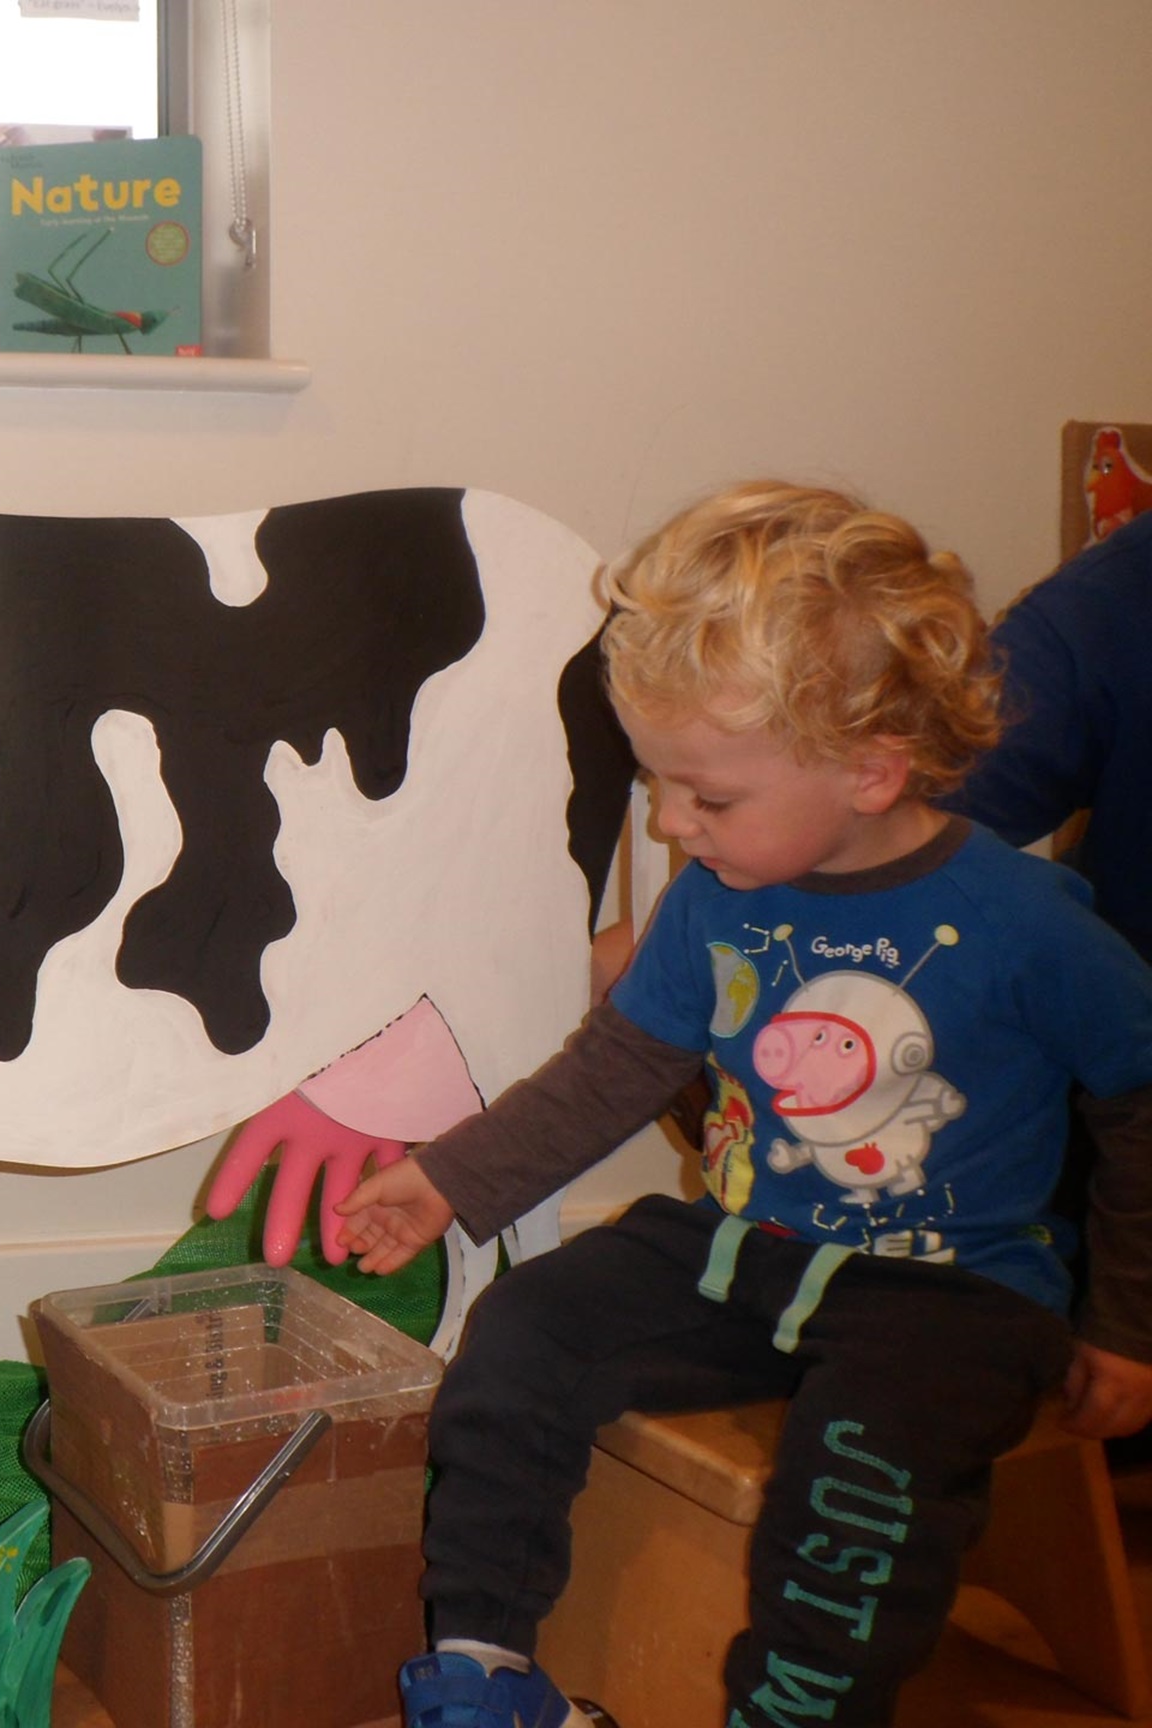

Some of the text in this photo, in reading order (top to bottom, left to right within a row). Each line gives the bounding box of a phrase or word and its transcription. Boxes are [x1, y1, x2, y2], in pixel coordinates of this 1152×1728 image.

[11, 174, 182, 216] Nature
[811, 935, 901, 969] George Pig
[783, 1420, 913, 1642] JUST
[728, 1650, 854, 1728] W
